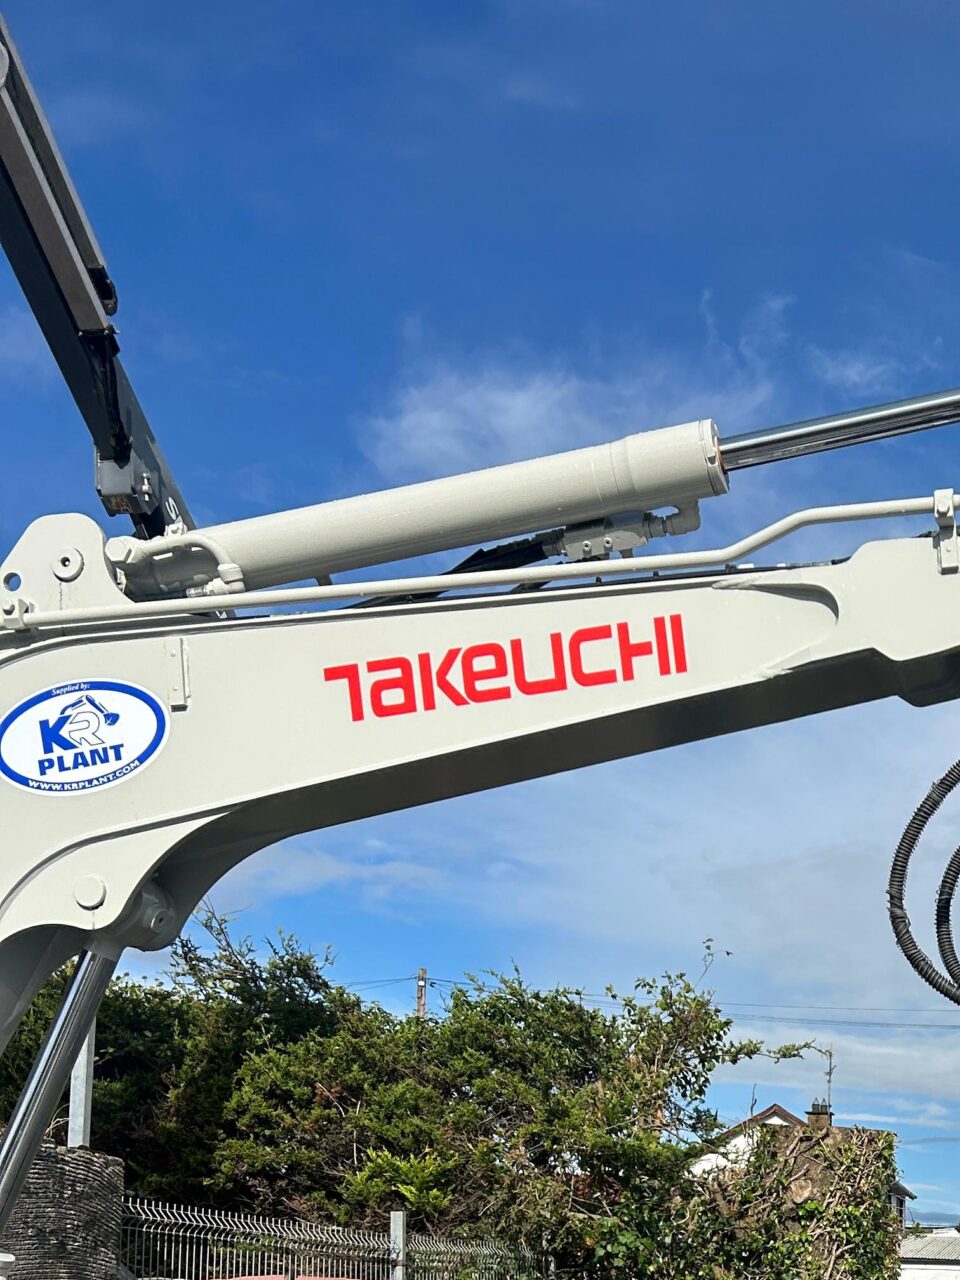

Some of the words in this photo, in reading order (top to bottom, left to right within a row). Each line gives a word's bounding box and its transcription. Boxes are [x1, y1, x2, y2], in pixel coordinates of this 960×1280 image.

[52, 683, 79, 696] Supplied
[80, 681, 90, 691] by:
[39, 711, 105, 754] KR
[28, 759, 140, 791] WWW.KRPLANT.COM
[38, 744, 124, 776] PLANT
